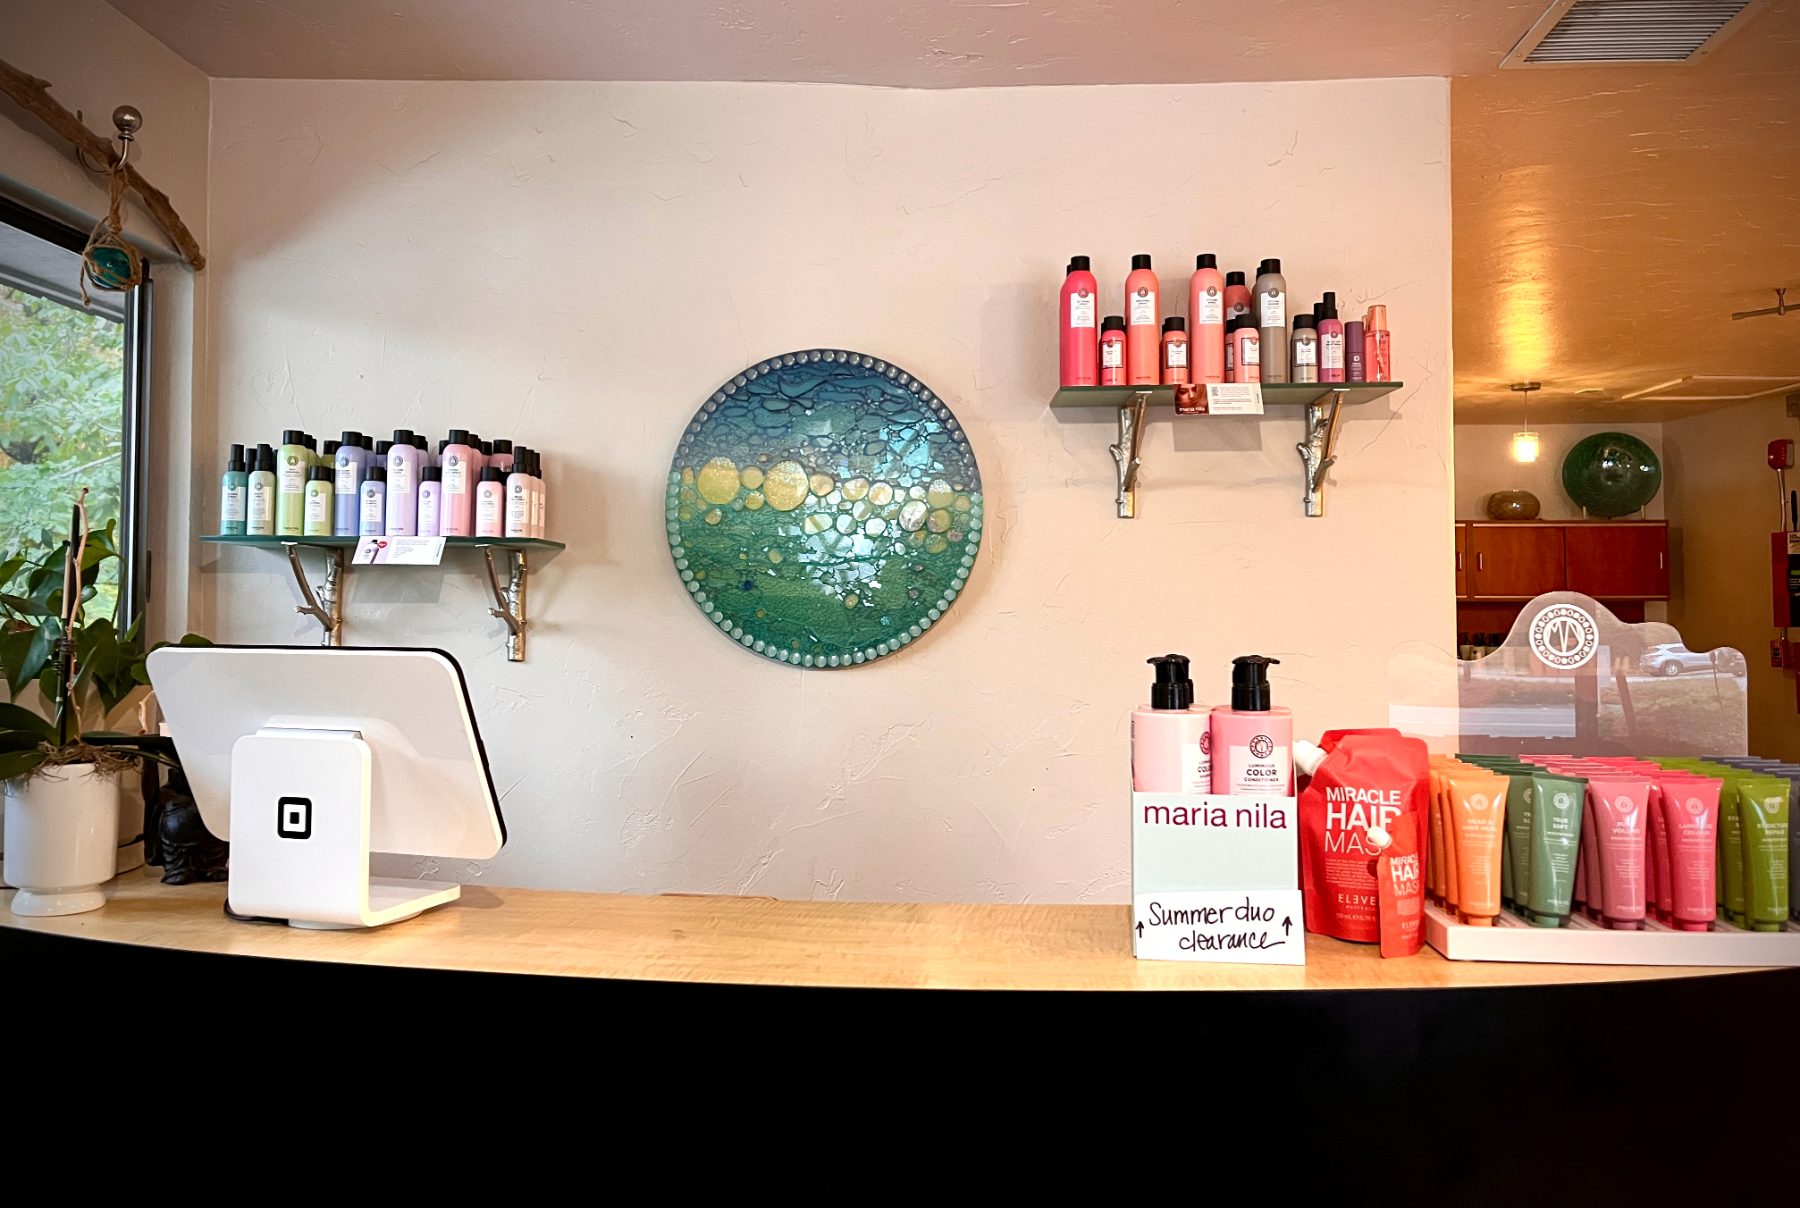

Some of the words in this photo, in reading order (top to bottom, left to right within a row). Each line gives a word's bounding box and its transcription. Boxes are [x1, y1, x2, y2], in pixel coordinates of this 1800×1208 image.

[1326, 787, 1402, 805] MIRACLE
[1144, 801, 1227, 827] maria
[1236, 803, 1287, 829] nila
[1325, 830, 1383, 855] MAS
[1393, 880, 1418, 896] MAS
[1149, 902, 1233, 926] Summer
[1235, 896, 1275, 922] duo
[1179, 930, 1285, 952] clearance
